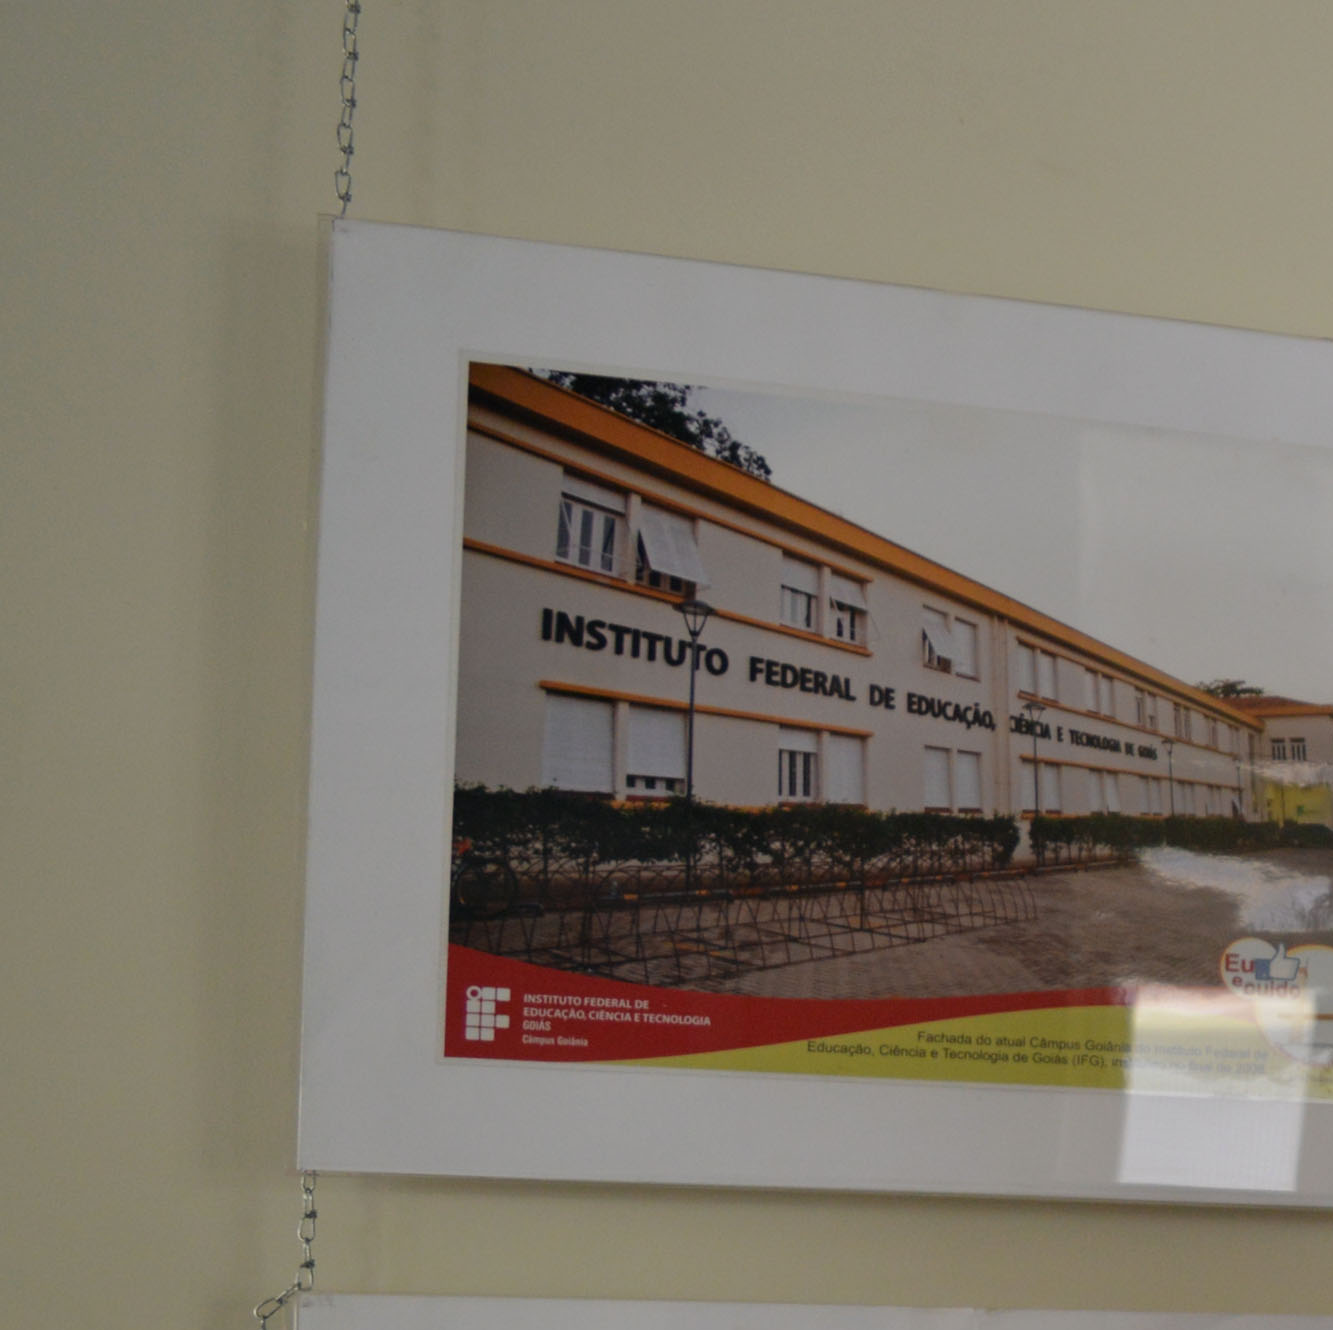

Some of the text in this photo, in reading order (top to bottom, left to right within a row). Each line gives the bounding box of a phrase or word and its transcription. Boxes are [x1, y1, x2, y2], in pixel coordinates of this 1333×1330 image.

[541, 607, 729, 677] INSTITUTO
[749, 655, 857, 702] FEDERAL
[868, 683, 896, 710] DE
[907, 691, 997, 732] EDUCAÇÃO,
[1056, 725, 1064, 742] E
[1225, 953, 1255, 973] Eu
[523, 993, 650, 1010] INSTITUTO FEDERAL DE
[522, 1019, 552, 1032] GOIÁS
[523, 1006, 712, 1027] EDUCAÇÃO, CIÊNCIA E TECNOLOGIA
[917, 1030, 972, 1045] Fachada
[976, 1034, 991, 1046] do
[995, 1036, 1026, 1047] atual
[1030, 1036, 1081, 1050] Câmpus
[807, 1040, 875, 1057] Educação,
[879, 1043, 926, 1058] Ciência
[930, 1049, 939, 1058] e
[943, 1047, 1009, 1064] Tecnologia
[1012, 1052, 1028, 1063] de
[1032, 1052, 1068, 1065] Goiás
